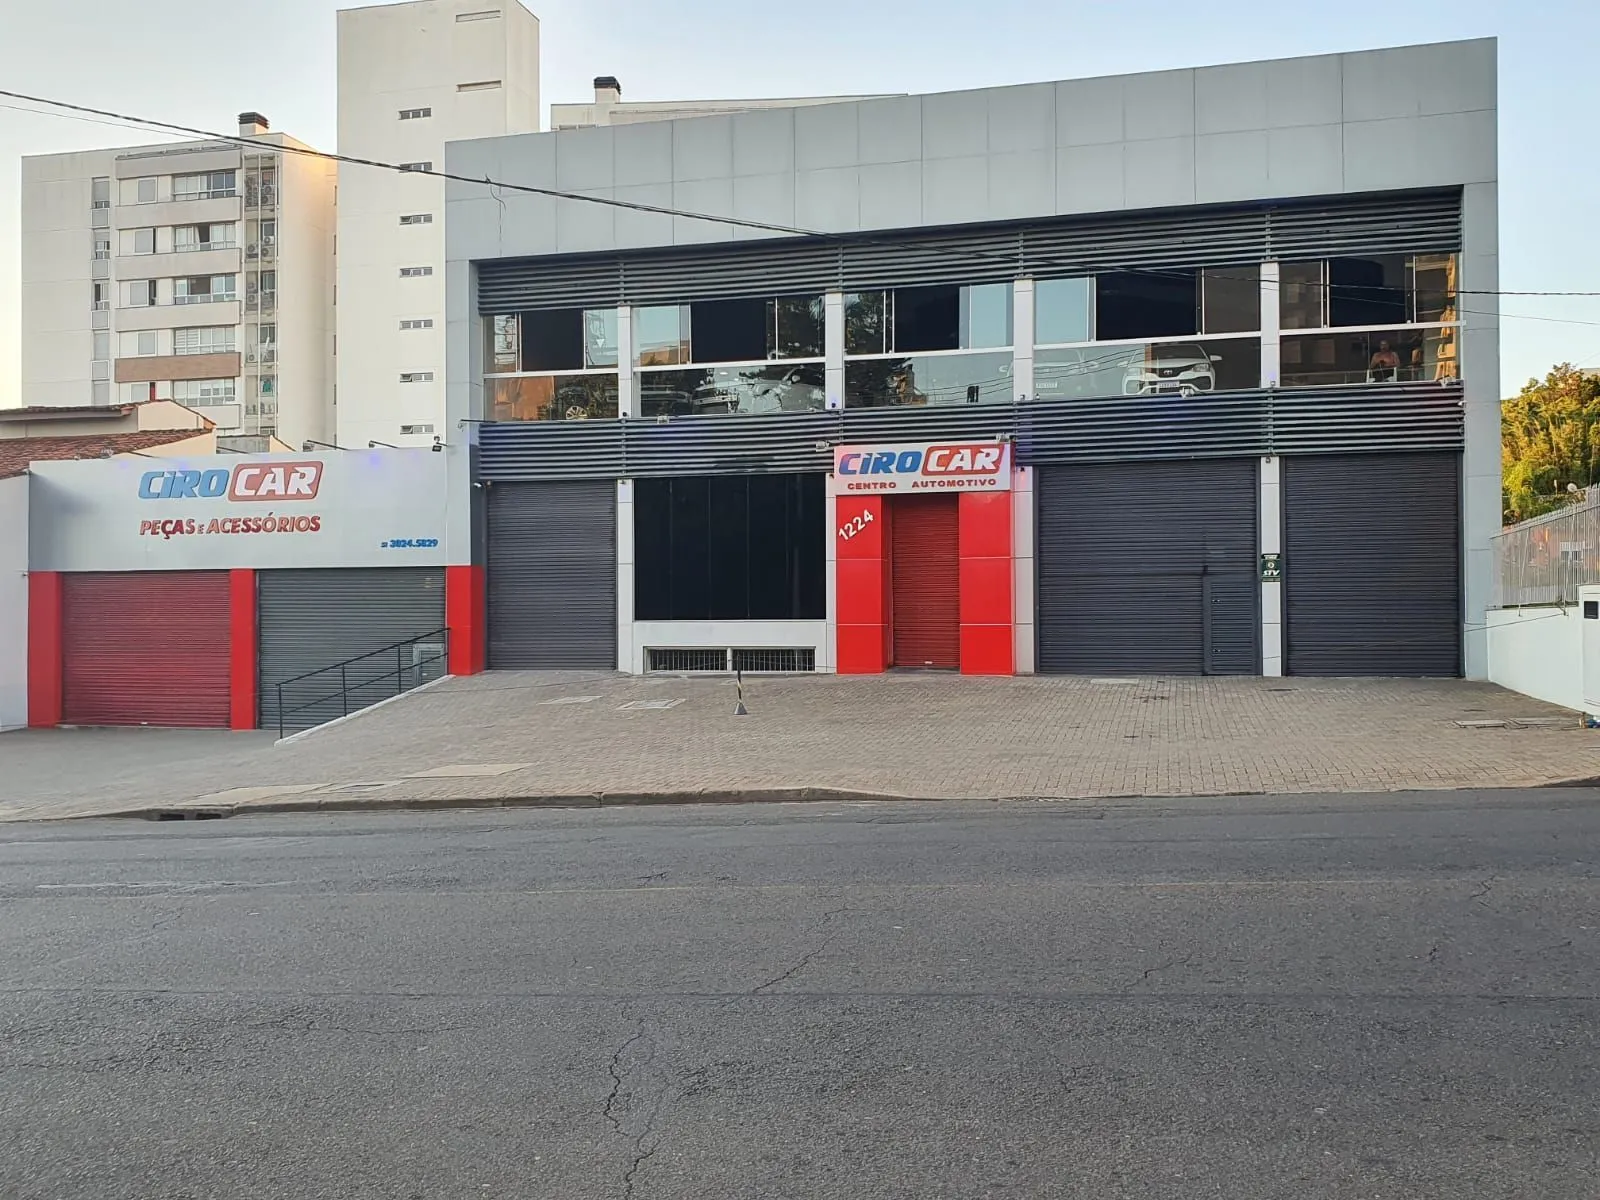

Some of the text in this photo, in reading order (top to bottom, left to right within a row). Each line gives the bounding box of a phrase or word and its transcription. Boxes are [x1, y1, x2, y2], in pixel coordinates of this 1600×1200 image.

[838, 449, 1000, 475] CIRO CAR
[138, 466, 317, 499] CIRO CAR
[847, 478, 997, 490] CENTRO AUTOMOTIVO
[139, 518, 196, 540] PEÇAS
[206, 512, 321, 534] ACESSÓRIOS
[838, 509, 874, 541] 1224
